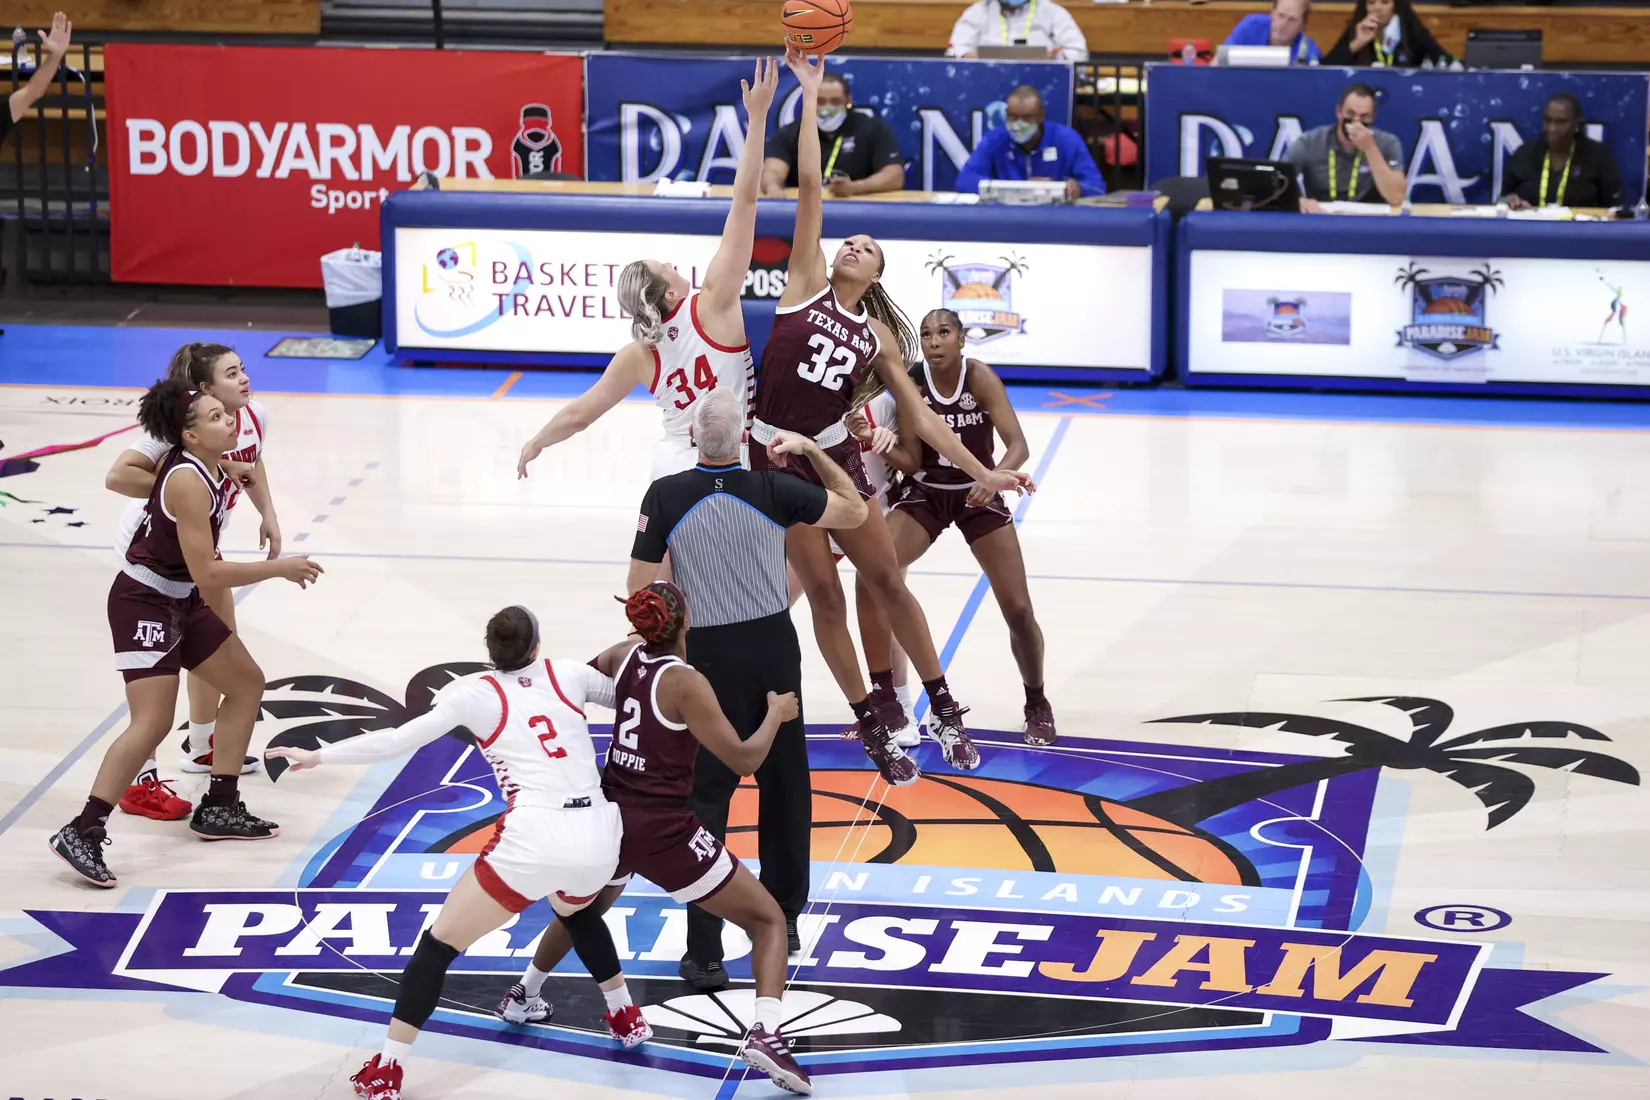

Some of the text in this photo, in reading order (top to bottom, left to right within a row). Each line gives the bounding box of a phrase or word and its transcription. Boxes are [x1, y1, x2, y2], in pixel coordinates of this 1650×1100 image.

[125, 118, 496, 181] BODYARMOR
[806, 309, 873, 358] TEXAS A&M
[666, 354, 718, 411] 34
[796, 332, 857, 392] 32
[956, 411, 985, 428] A&M
[528, 714, 568, 759] 2
[619, 697, 641, 750] 2
[911, 875, 1254, 914] ISLANDS
